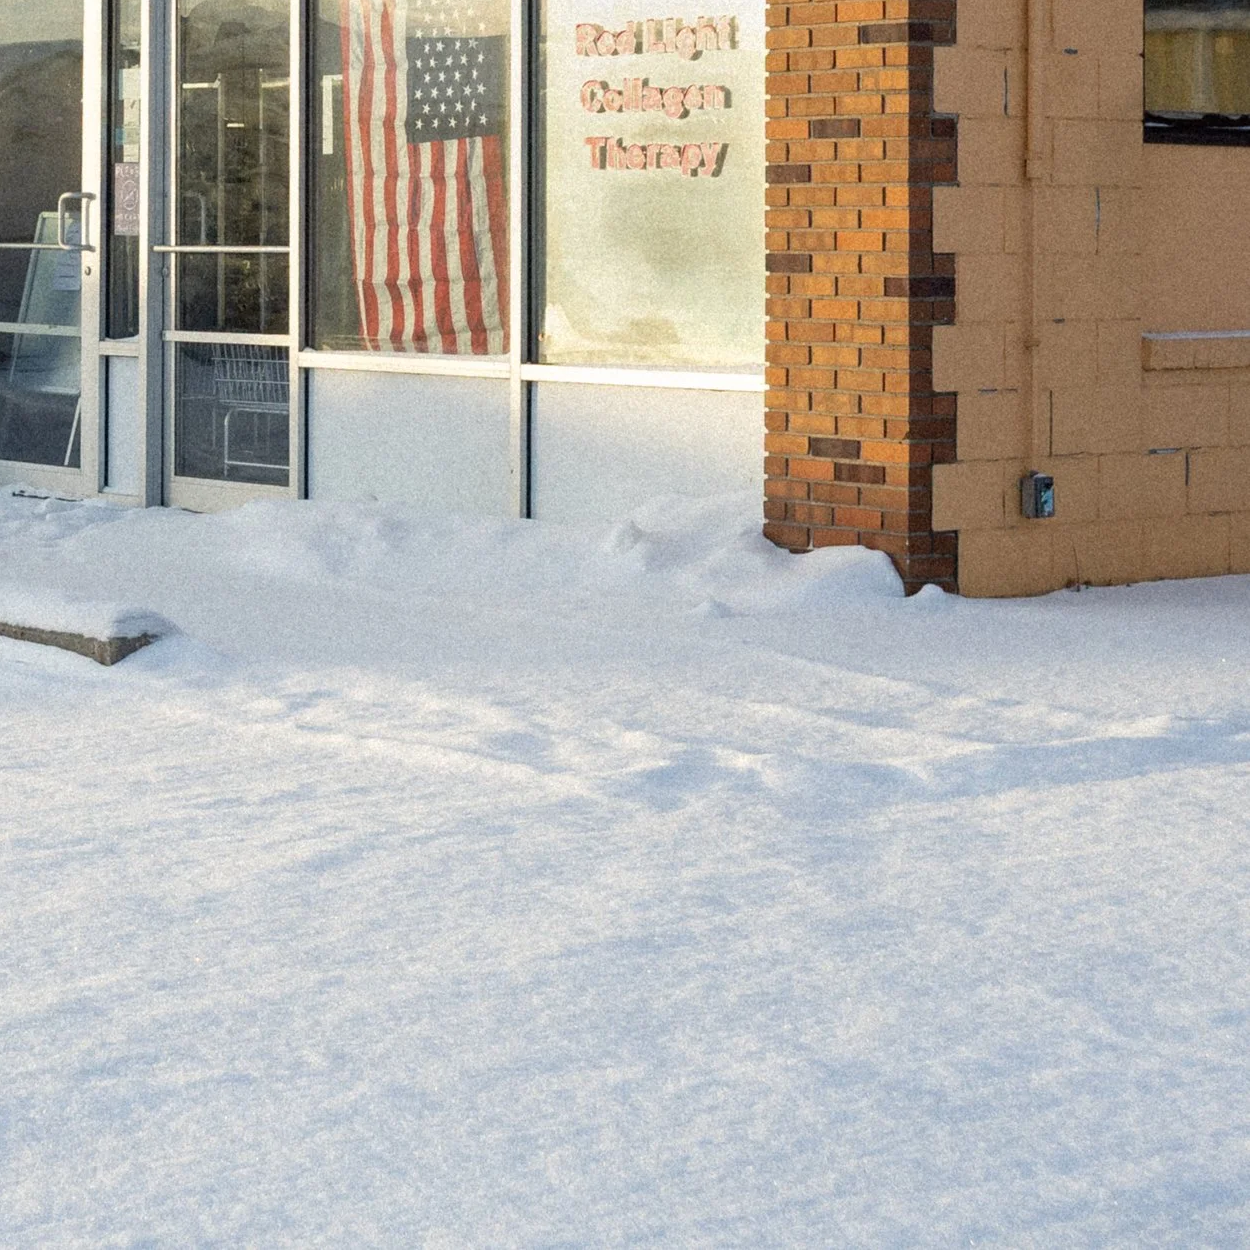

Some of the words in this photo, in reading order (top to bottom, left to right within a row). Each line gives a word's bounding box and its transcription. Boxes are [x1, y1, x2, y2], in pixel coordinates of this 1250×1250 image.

[575, 20, 637, 57] Red
[645, 15, 733, 60] Light
[579, 77, 726, 119] Collagen
[584, 136, 721, 176] Therapy
